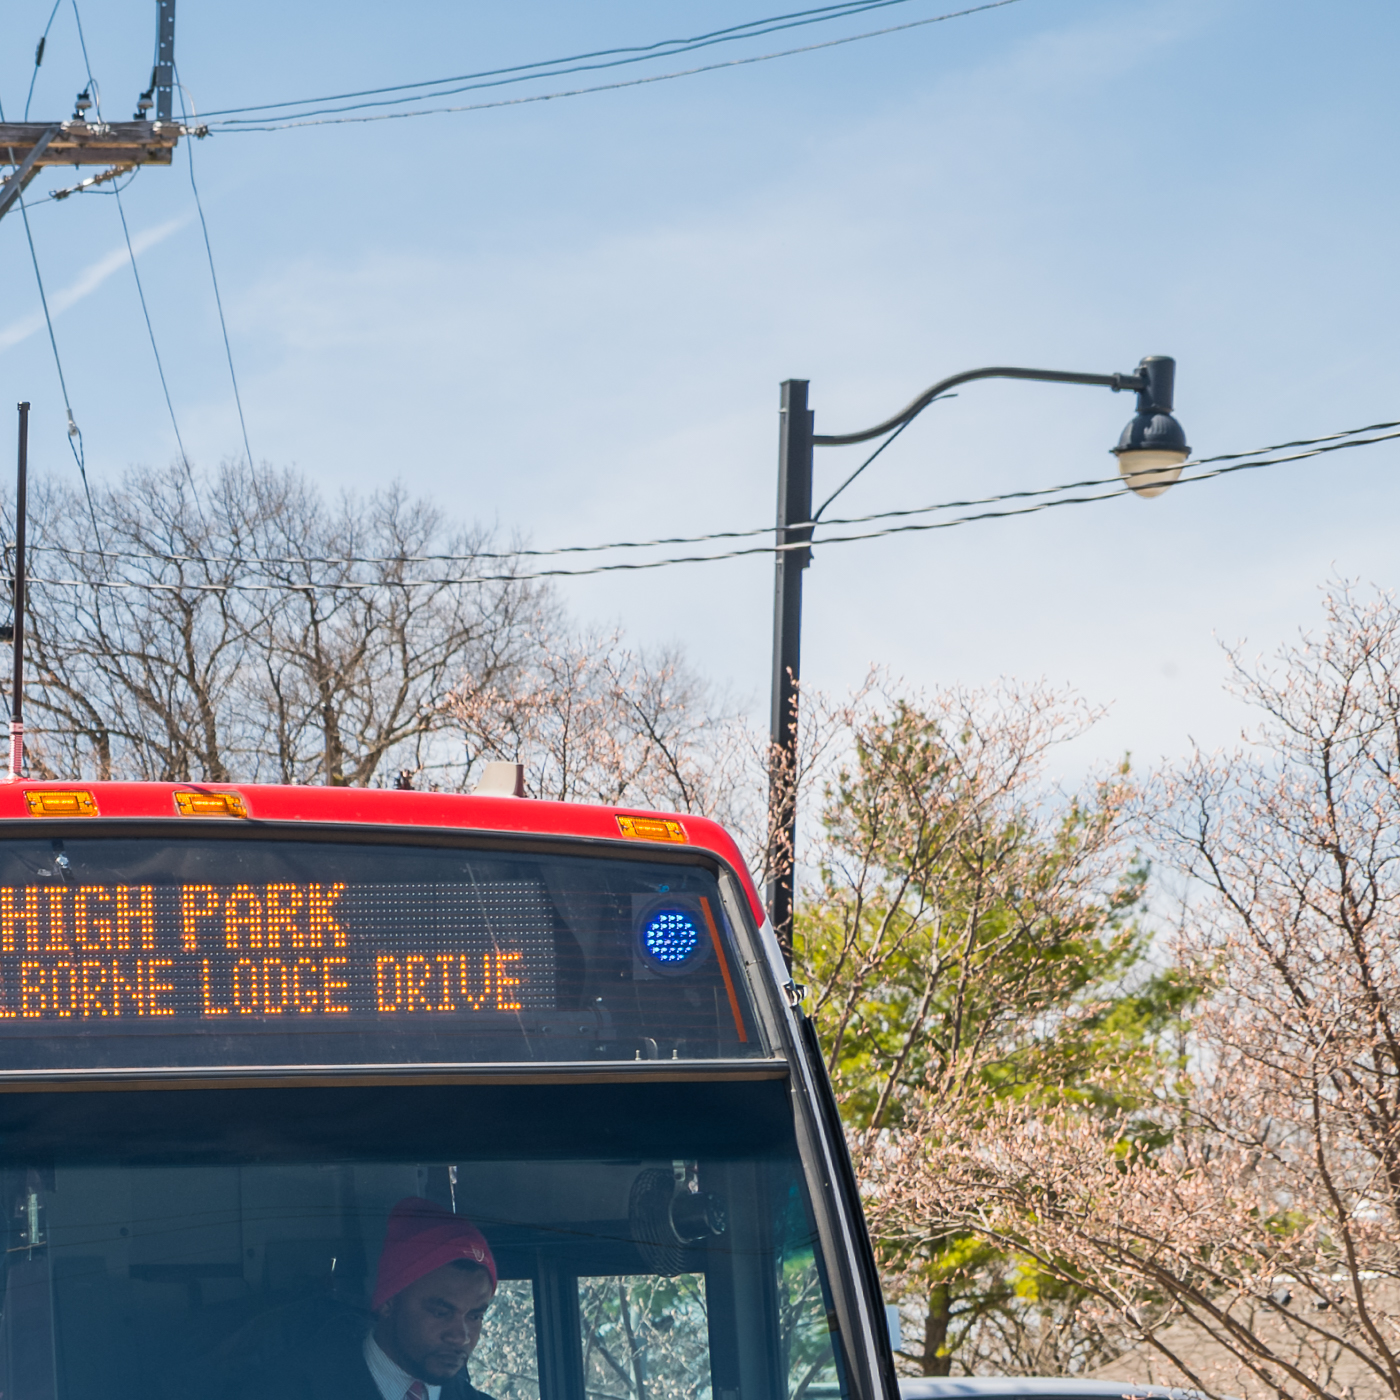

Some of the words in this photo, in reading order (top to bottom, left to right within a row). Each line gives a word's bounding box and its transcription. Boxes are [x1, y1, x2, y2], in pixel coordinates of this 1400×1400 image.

[0, 884, 155, 953] HIGH
[181, 882, 349, 950] PARK
[202, 956, 350, 1015] LODGE
[376, 951, 525, 1012] DRIVE
